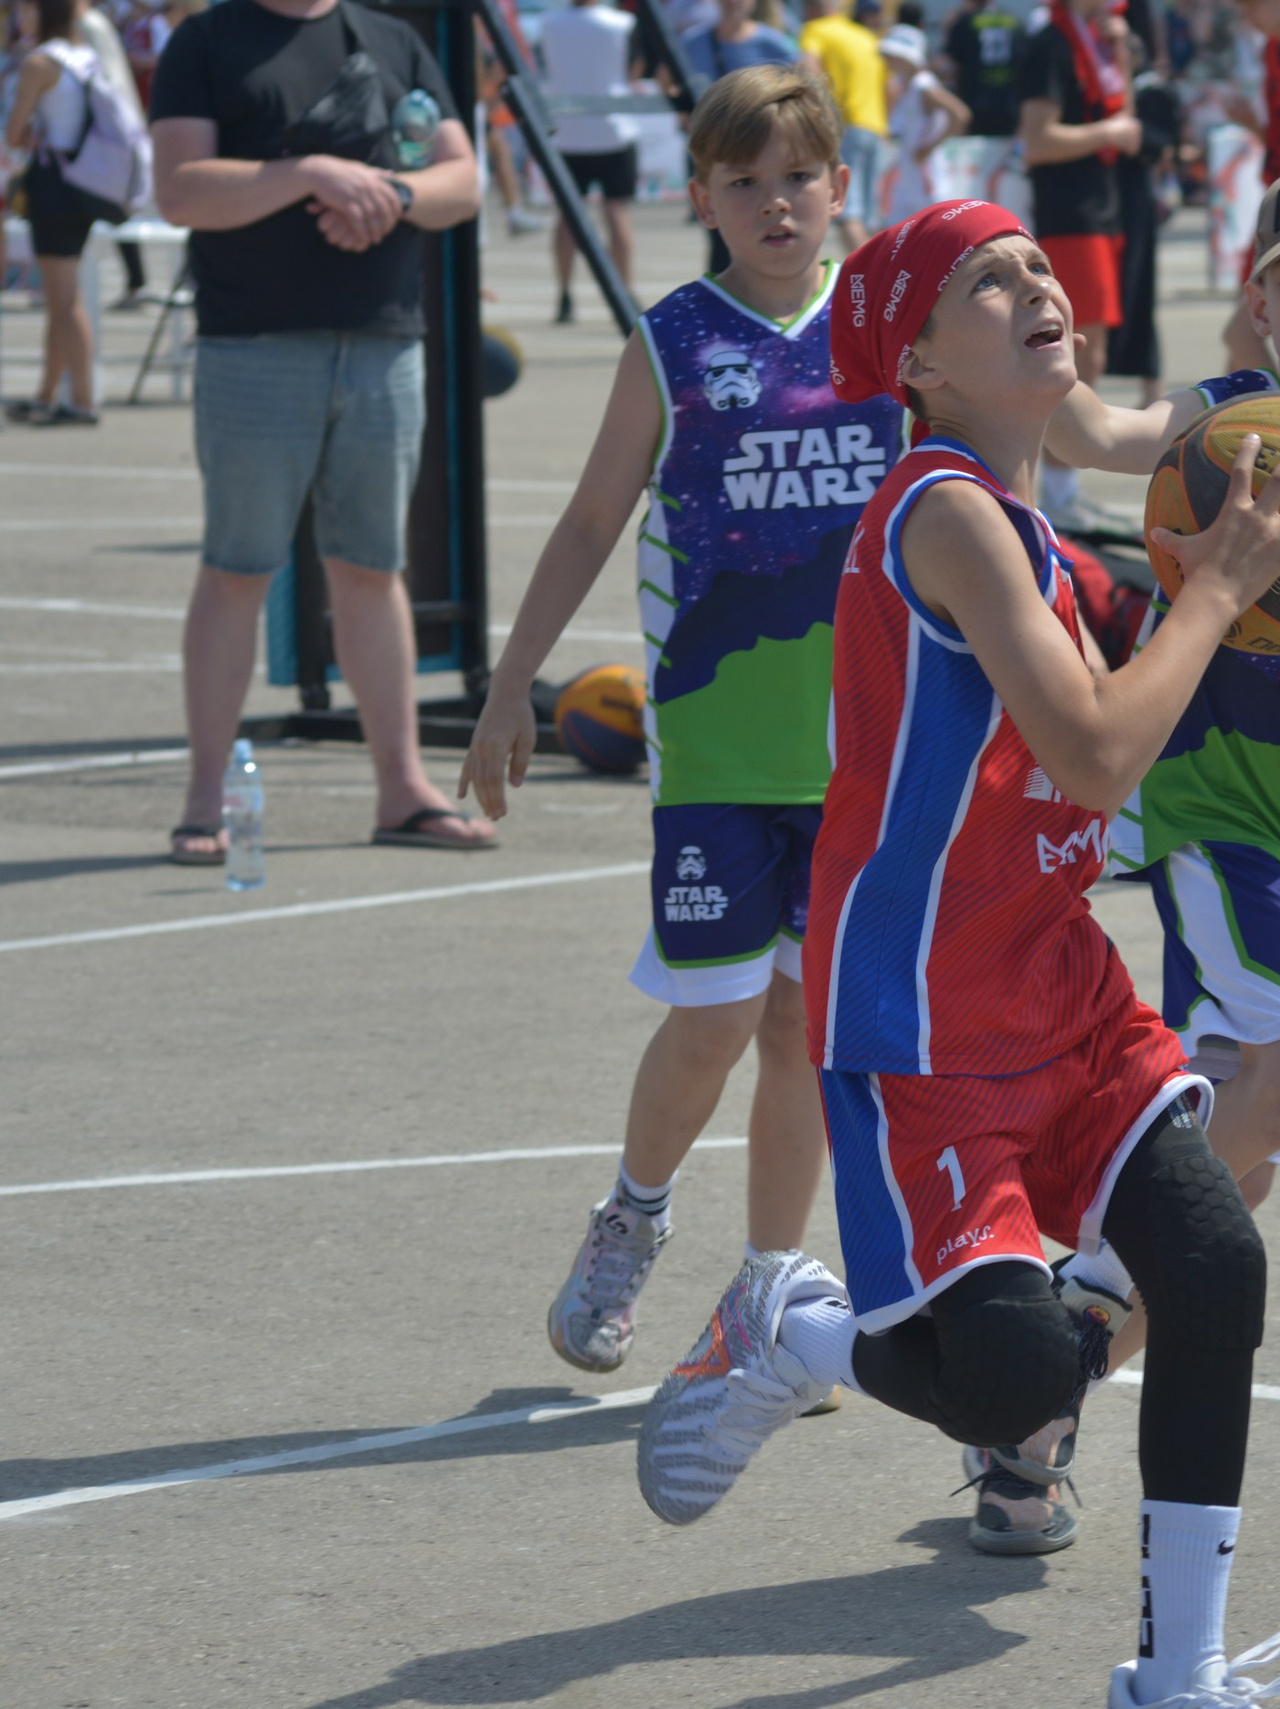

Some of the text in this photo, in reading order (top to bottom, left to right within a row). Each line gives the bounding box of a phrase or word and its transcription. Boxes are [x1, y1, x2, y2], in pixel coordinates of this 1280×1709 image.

[723, 423, 886, 472] STAR
[722, 463, 887, 511] WARS
[664, 885, 729, 904] STAR
[664, 902, 729, 922] WARS
[936, 1145, 966, 1212] 1
